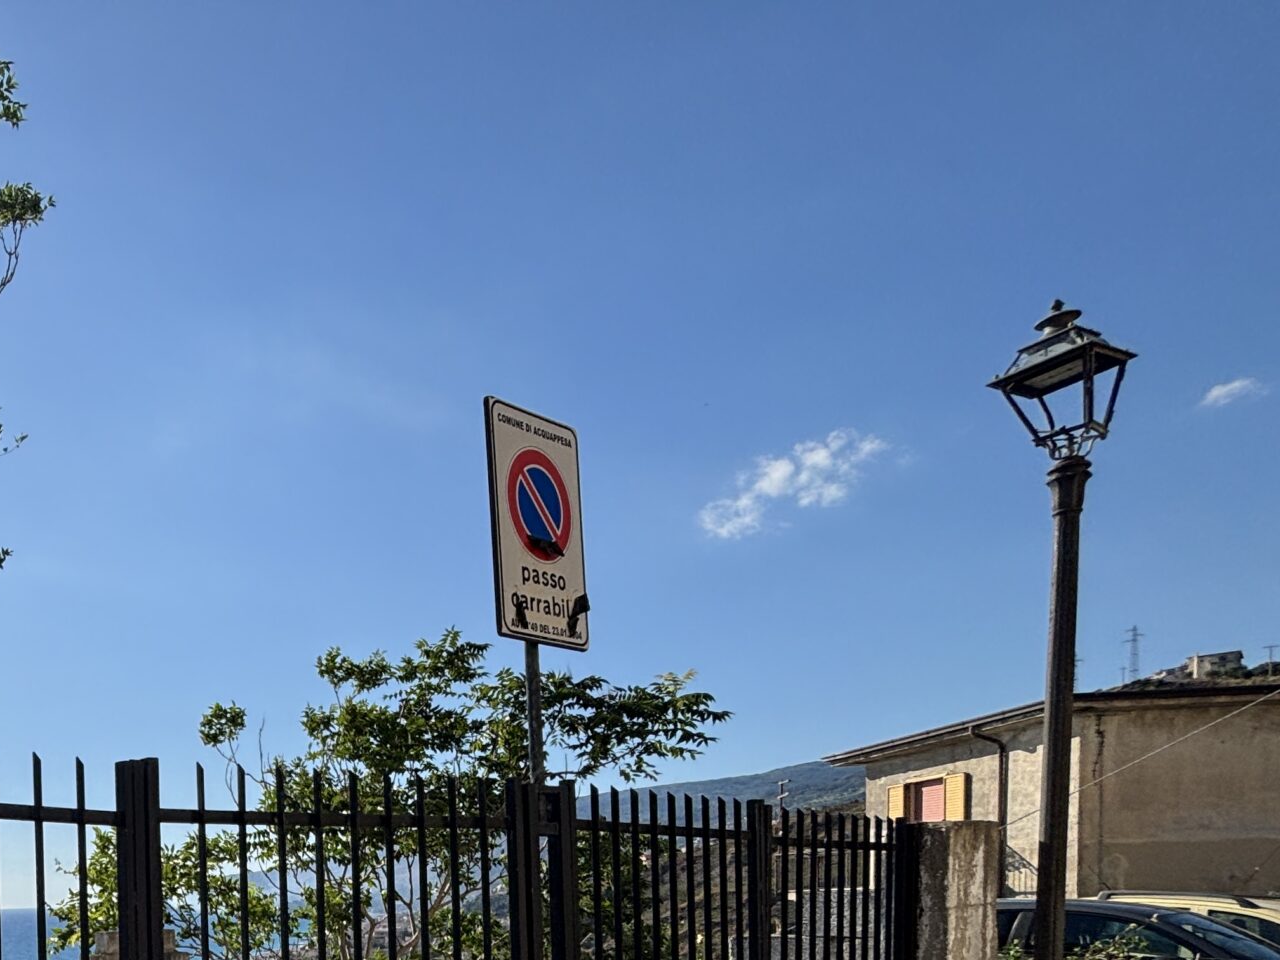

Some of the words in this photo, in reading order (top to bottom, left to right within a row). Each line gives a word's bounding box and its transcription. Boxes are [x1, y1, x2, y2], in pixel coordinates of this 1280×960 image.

[497, 412, 525, 431] COMUNE
[525, 422, 532, 433] DI
[534, 426, 572, 448] ACQUAPPESA
[521, 565, 566, 591] passo
[511, 591, 573, 620] carrabil
[539, 623, 551, 635] DEL
